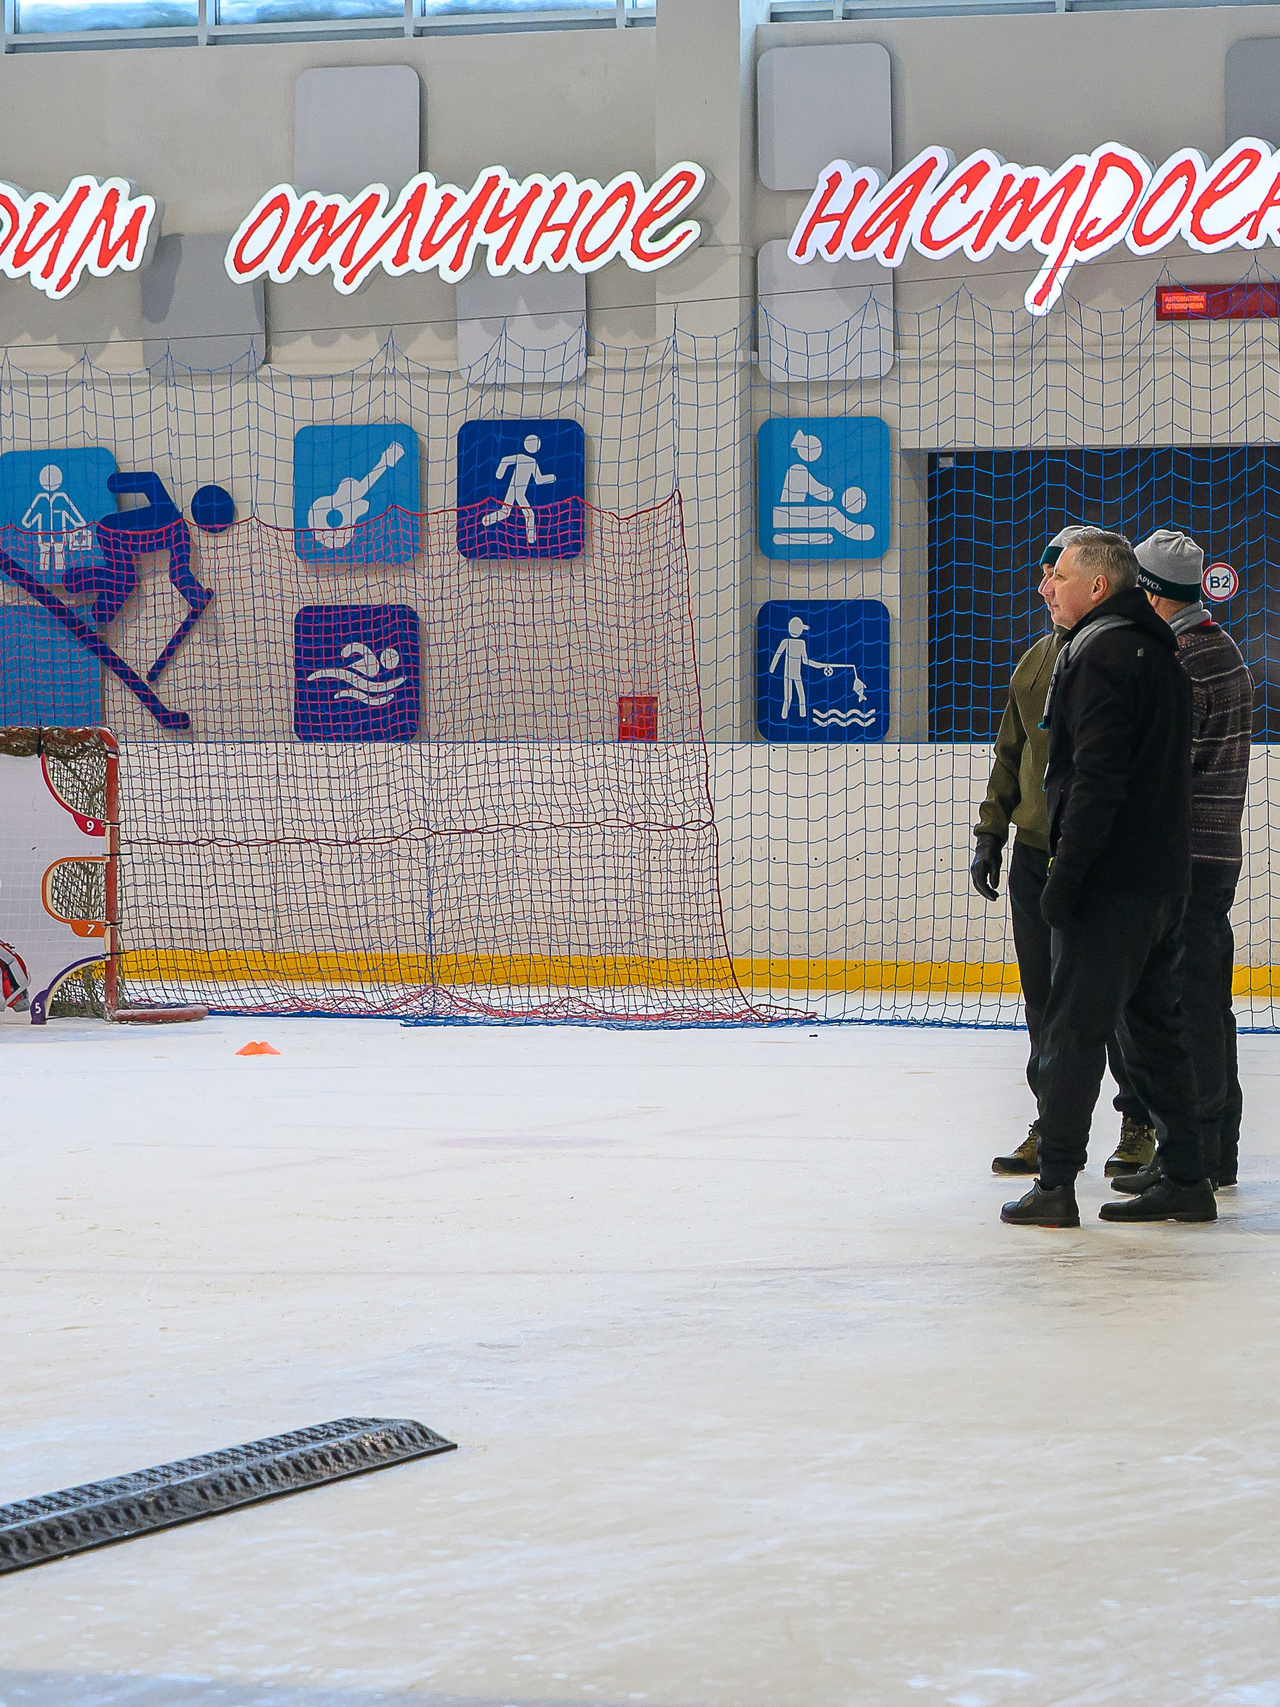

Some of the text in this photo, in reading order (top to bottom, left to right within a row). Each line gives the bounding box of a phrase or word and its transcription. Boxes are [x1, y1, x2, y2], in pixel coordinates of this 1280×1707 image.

[232, 170, 698, 286] отличное
[86, 820, 95, 832] 9
[87, 923, 95, 935] 7
[34, 1002, 42, 1014] 5
